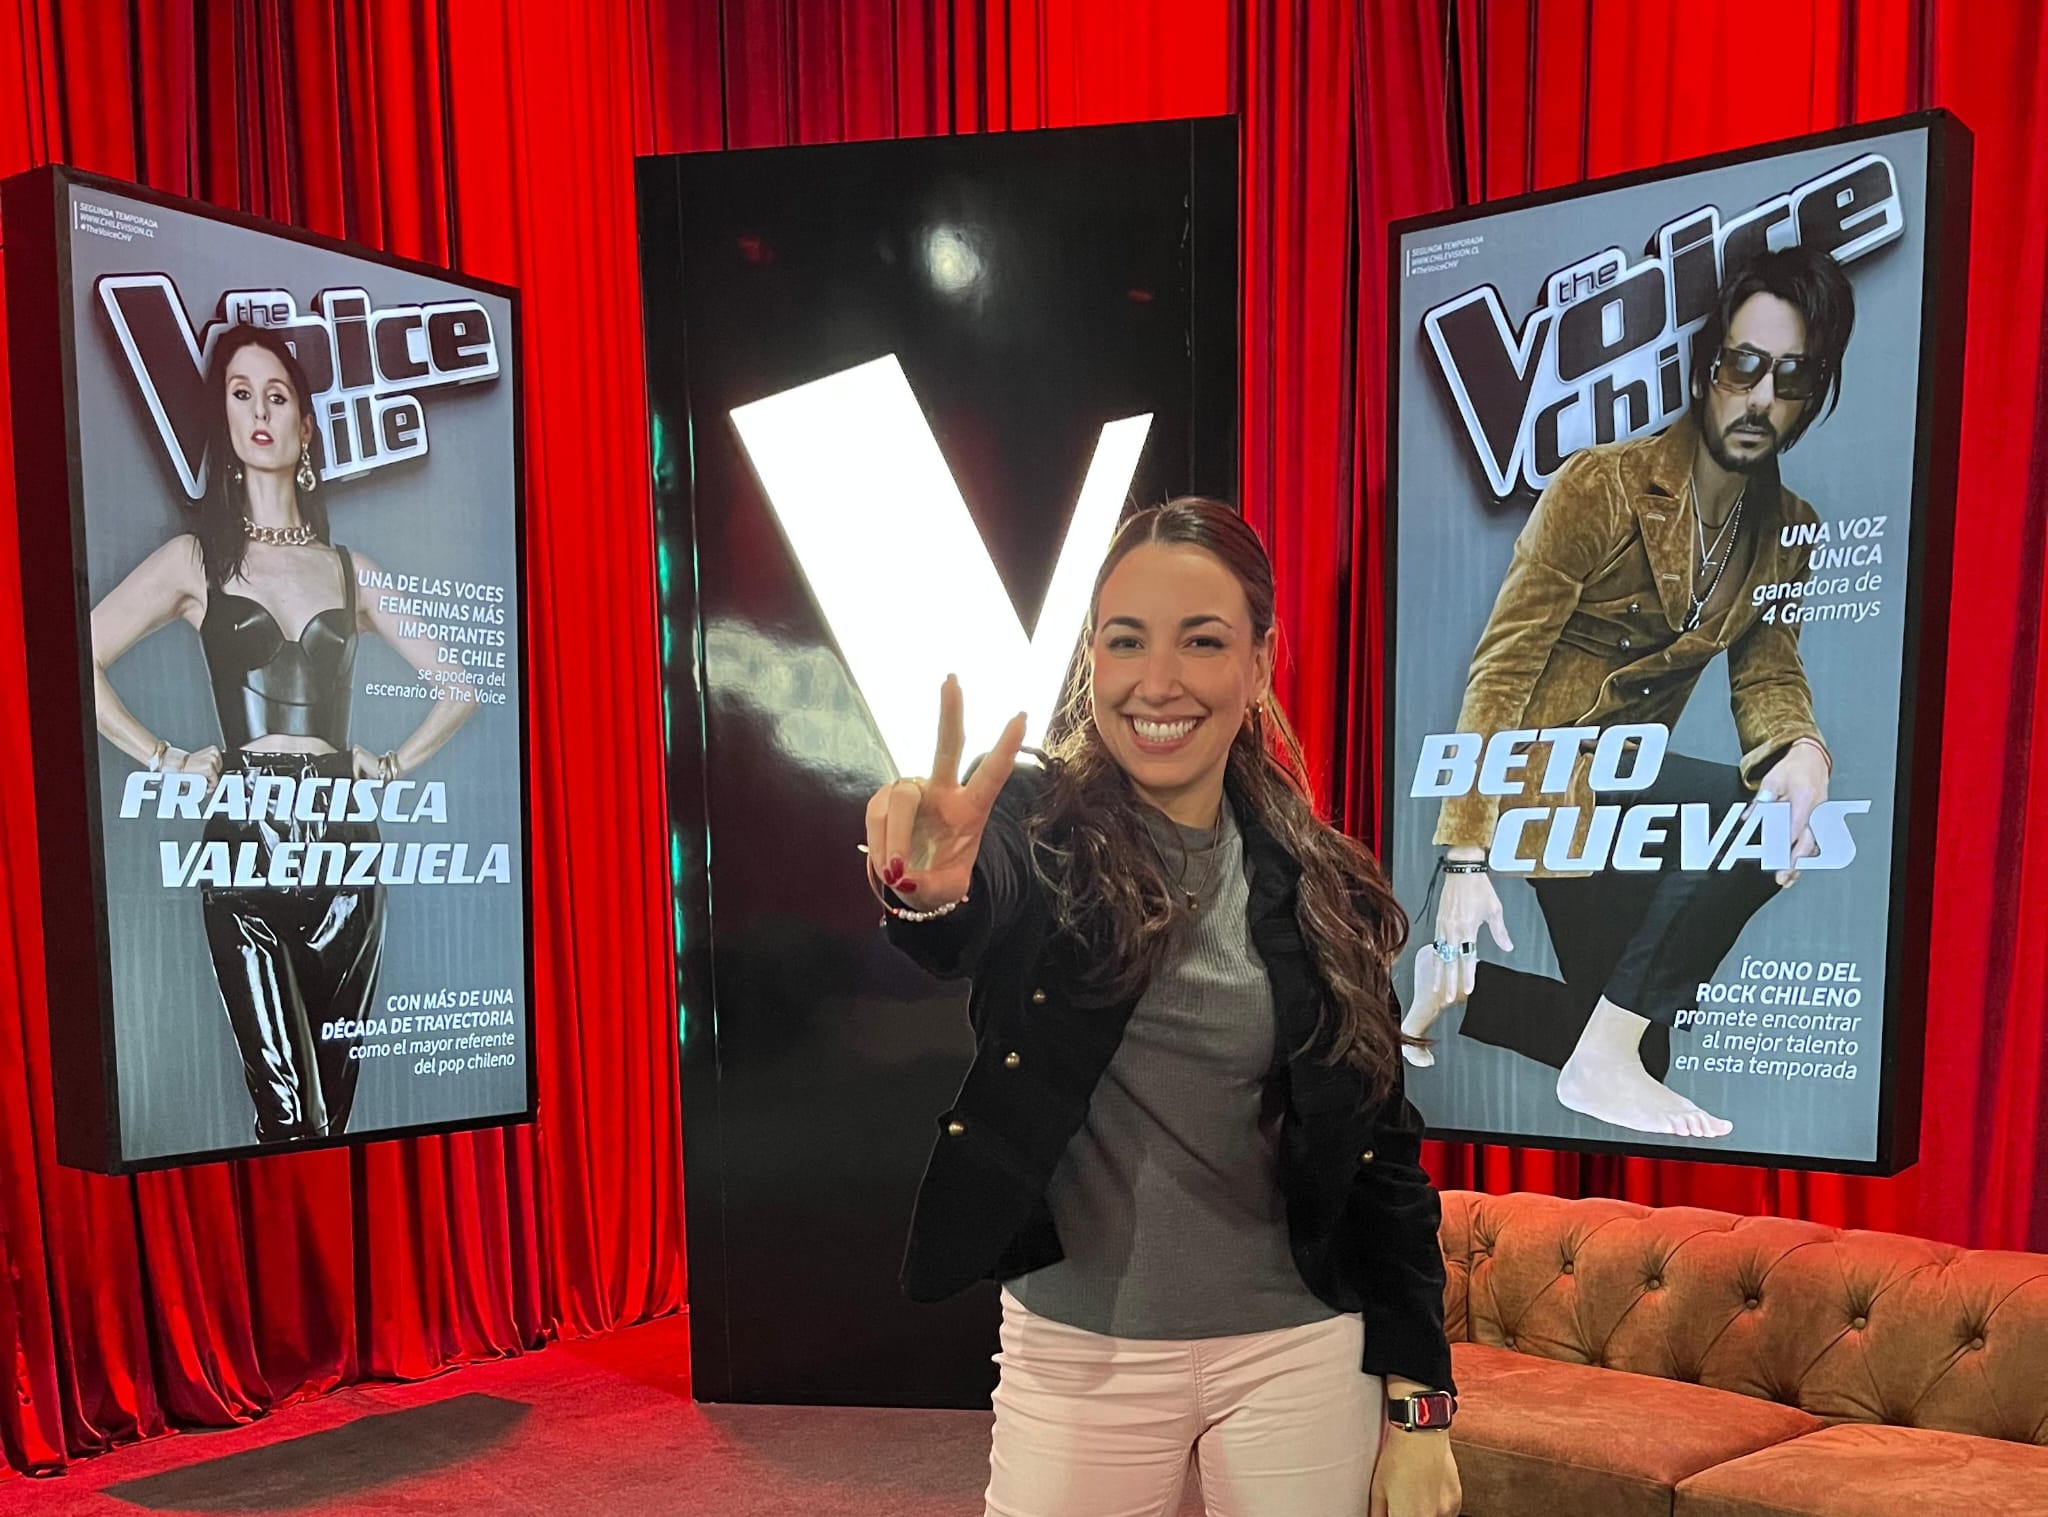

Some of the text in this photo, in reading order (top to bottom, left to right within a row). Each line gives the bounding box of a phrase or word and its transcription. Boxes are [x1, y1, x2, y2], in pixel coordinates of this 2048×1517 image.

[80, 202, 158, 228] SEGUNDA TEMPORADA
[80, 213, 154, 237] WWW.CHILEVISION.CL
[1443, 236, 1484, 251] TEMPORADA
[1558, 260, 1619, 304] the
[233, 298, 290, 327] the
[1427, 156, 1902, 494] Voice
[1533, 336, 1700, 477] Chi
[1781, 516, 1887, 547] UNA VOZ
[1808, 543, 1883, 570] ÚNICA
[358, 569, 504, 603] UNA DE LAS VOCES
[729, 376, 1153, 779] V
[1751, 570, 1882, 607] ganadora de
[379, 596, 505, 625] FEMENINAS MÁS
[1762, 600, 1881, 625] 4 Grammys
[399, 621, 505, 647] IMPORTANTES
[438, 647, 506, 668] DE CHILE
[417, 668, 505, 687] se apodera del
[365, 682, 506, 705] escenario de The Voice
[1409, 722, 1670, 798] BETO
[119, 771, 449, 824] FRANCISCA
[1487, 800, 1872, 872] CUEVAS
[159, 840, 511, 889] VALENZUELA
[1740, 955, 1862, 982] ÍCONO DEL
[387, 988, 514, 1012] CON MÁS DE UNA
[1696, 982, 1862, 1007] ROCK CHILENO
[321, 1009, 514, 1040] DÉCADA DE TRAYECTORIA
[1673, 1009, 1862, 1032] promete encontrar
[349, 1032, 515, 1060] como el mayor referente
[1702, 1031, 1859, 1056] al mejor talento
[414, 1052, 515, 1077] del pop chileno
[1675, 1055, 1857, 1081] en esta temporada
